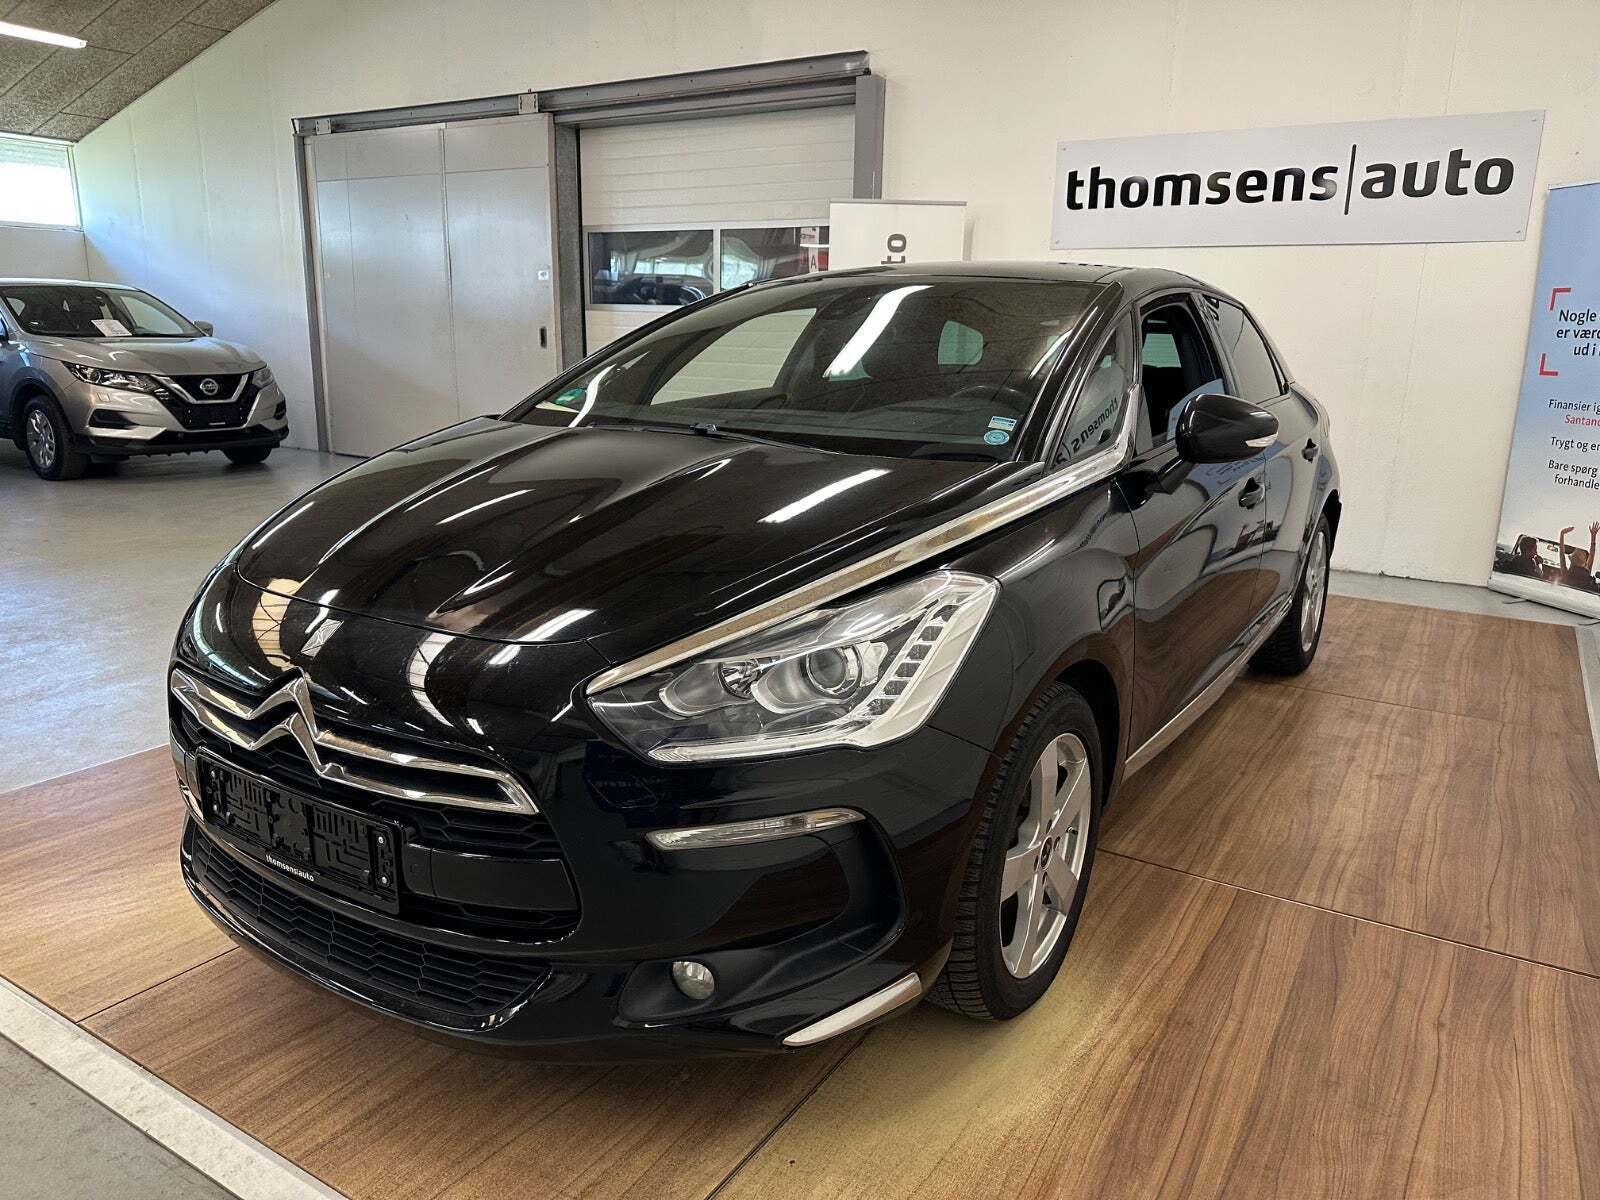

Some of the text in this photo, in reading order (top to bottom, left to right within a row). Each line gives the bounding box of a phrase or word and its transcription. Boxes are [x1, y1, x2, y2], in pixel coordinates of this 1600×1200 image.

[1558, 308, 1597, 326] Nogle
[1556, 328, 1570, 339] er
[1573, 342, 1597, 356] ud i
[1548, 399, 1591, 411] Finansier
[1551, 436, 1574, 450] Trygt
[1576, 441, 1589, 453] og
[1548, 459, 1598, 478] Bare spørg
